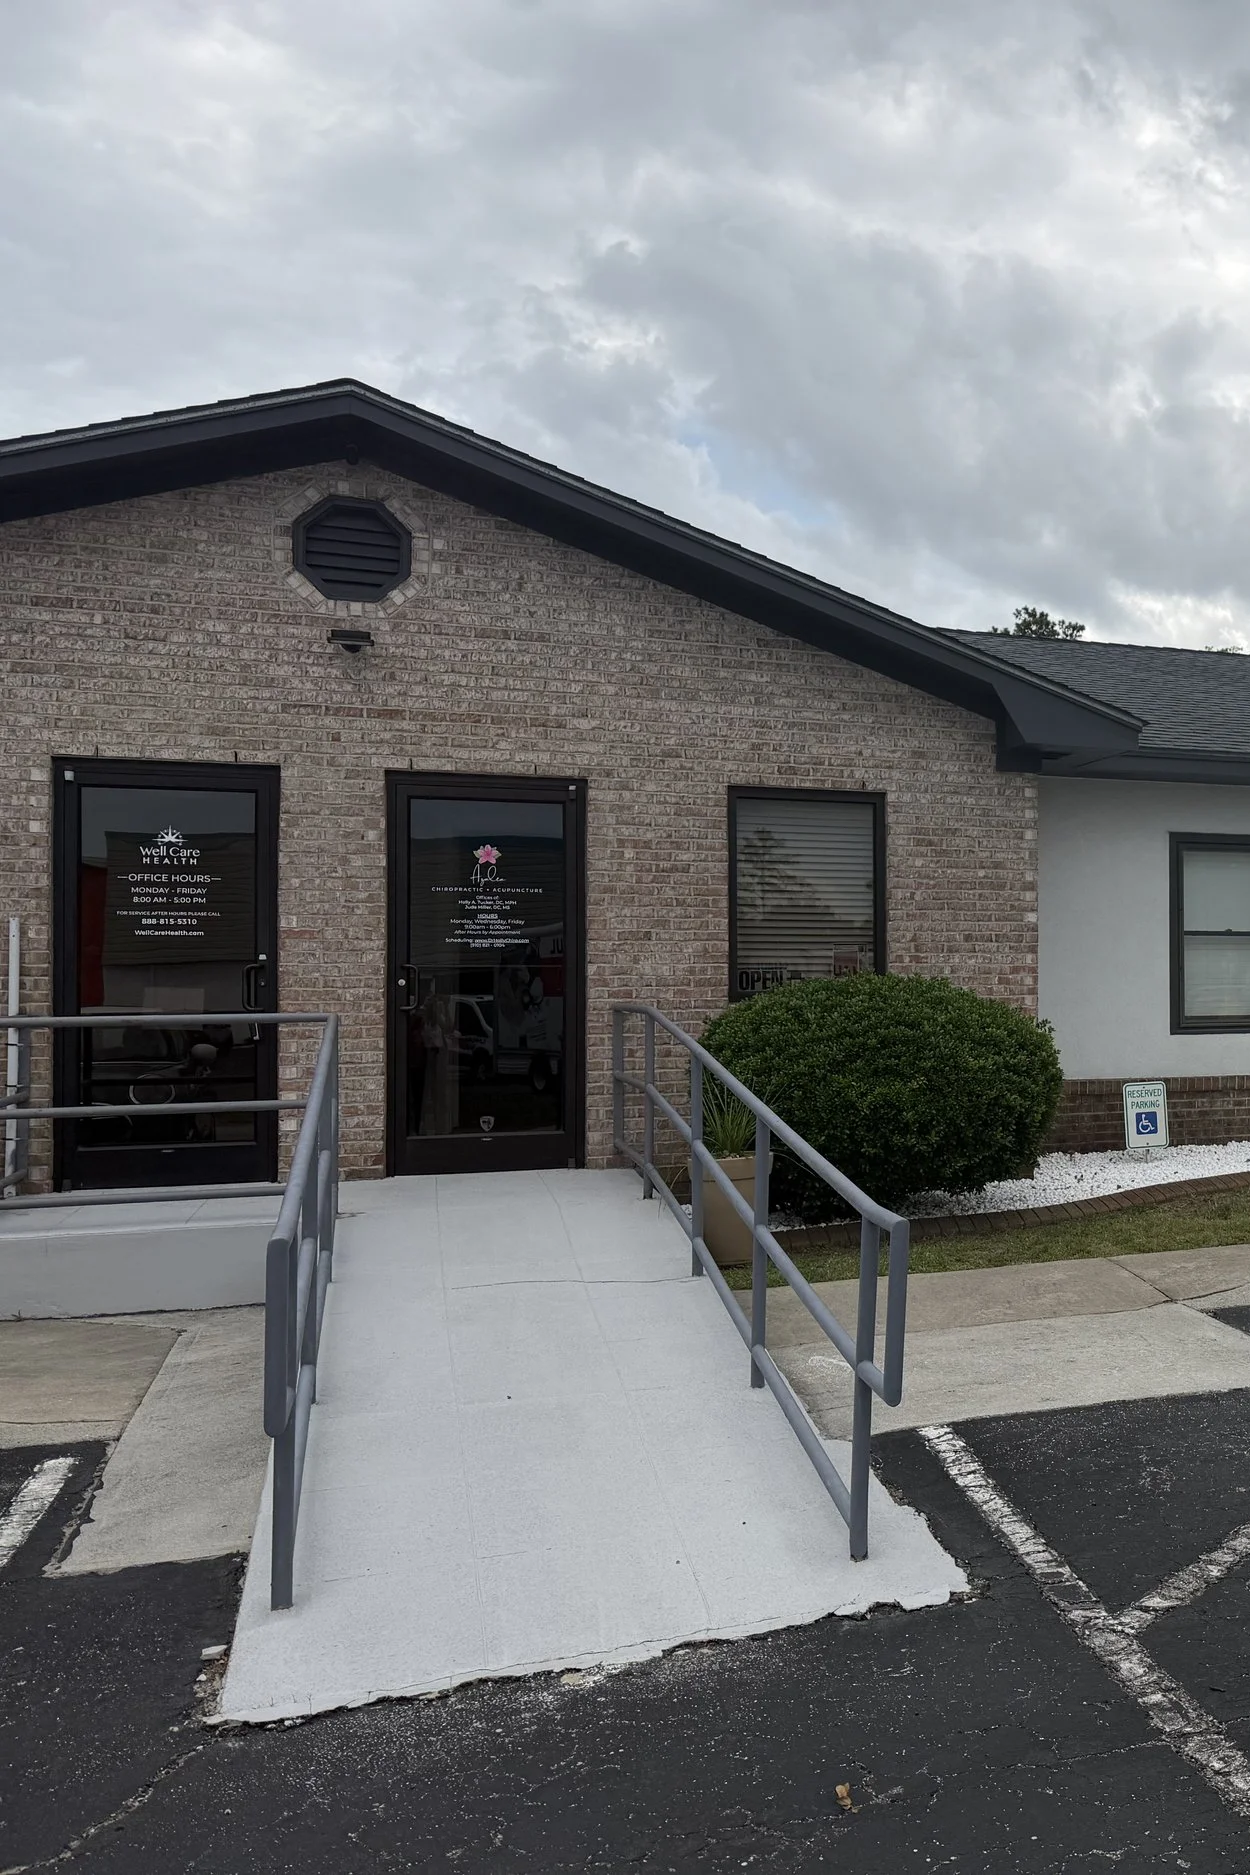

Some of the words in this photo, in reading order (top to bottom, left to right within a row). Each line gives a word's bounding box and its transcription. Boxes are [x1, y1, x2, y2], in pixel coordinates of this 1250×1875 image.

[140, 846, 167, 856] Well
[169, 847, 201, 857] Care
[142, 857, 197, 865] HEALTH
[128, 873, 169, 882] OFFICE
[171, 874, 211, 883] HOURS
[470, 863, 507, 887] Azalea
[176, 887, 207, 895] FRIDAY
[738, 970, 784, 991] OPEN
[1127, 1088, 1163, 1099] RESERVED
[1130, 1100, 1161, 1110] PARKING
